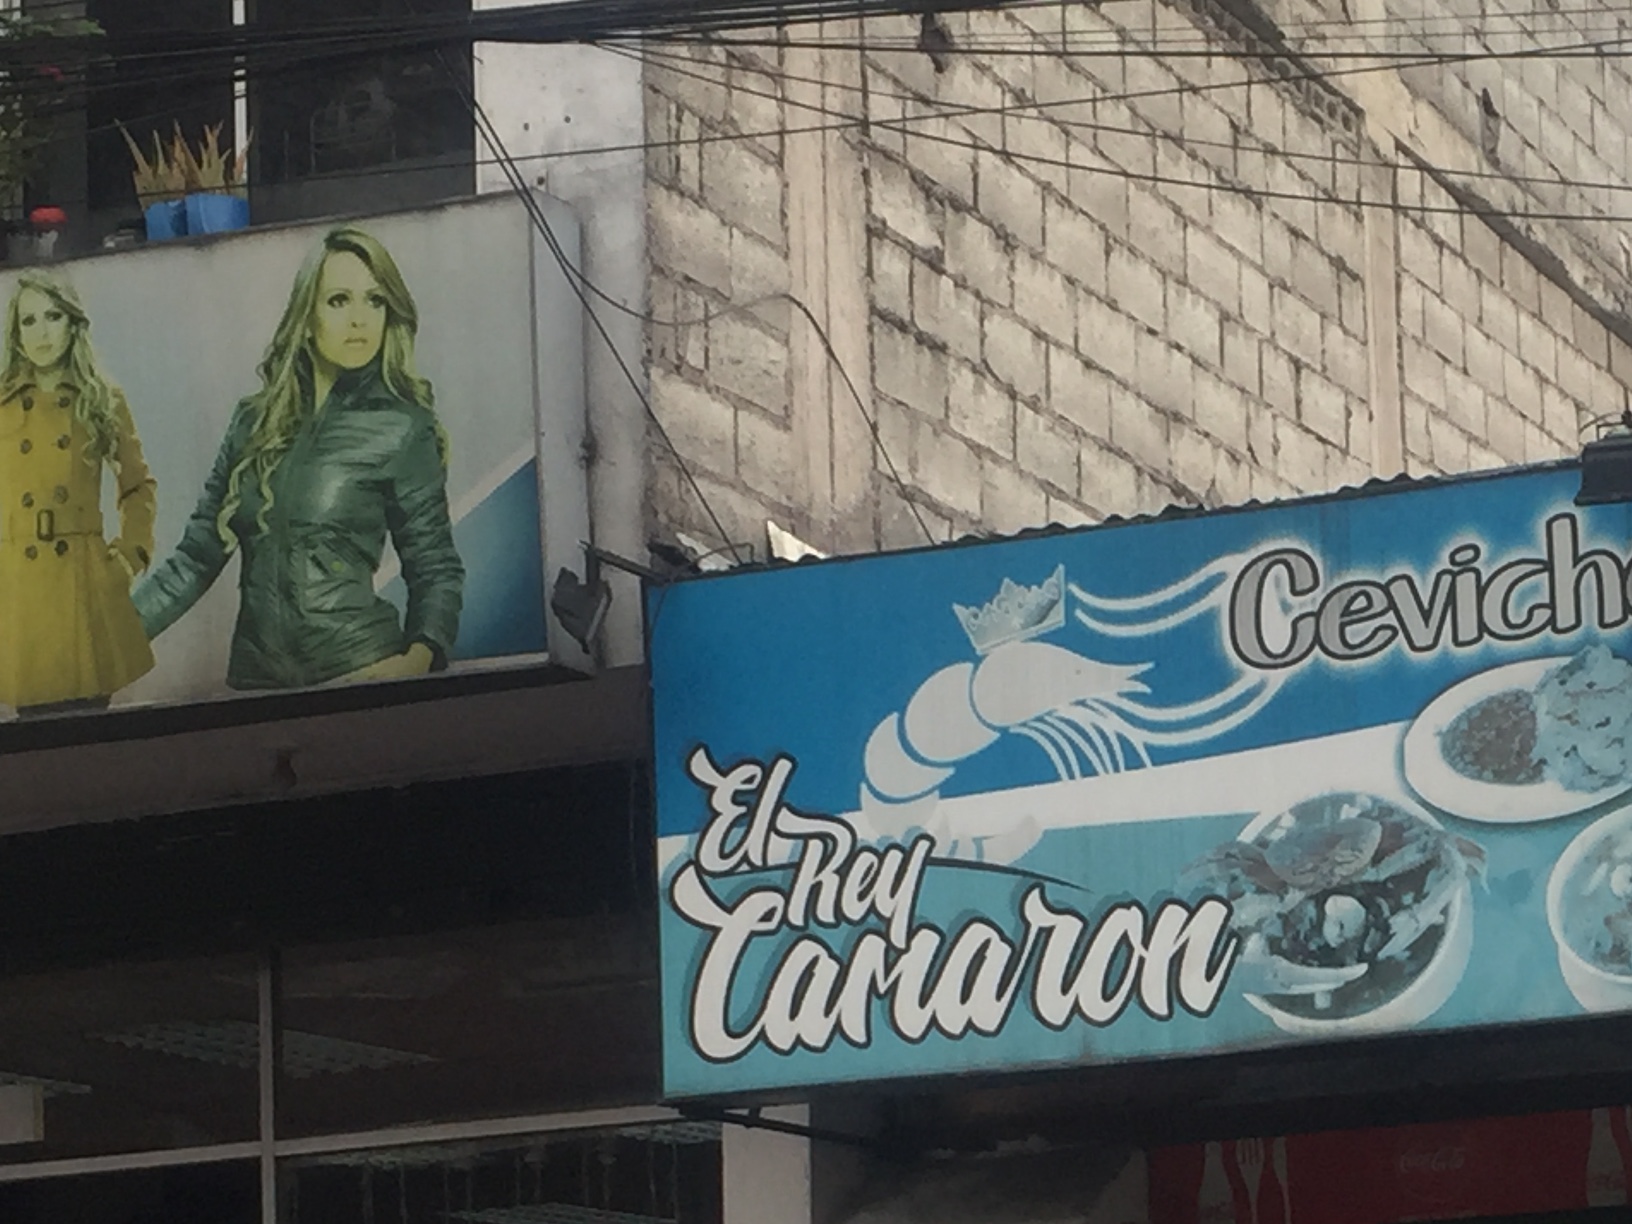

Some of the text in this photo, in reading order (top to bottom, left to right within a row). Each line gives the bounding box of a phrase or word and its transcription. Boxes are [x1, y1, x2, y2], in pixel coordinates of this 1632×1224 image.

[689, 744, 795, 876] El
[774, 806, 933, 948] Rey
[672, 864, 1241, 1062] Camaron
